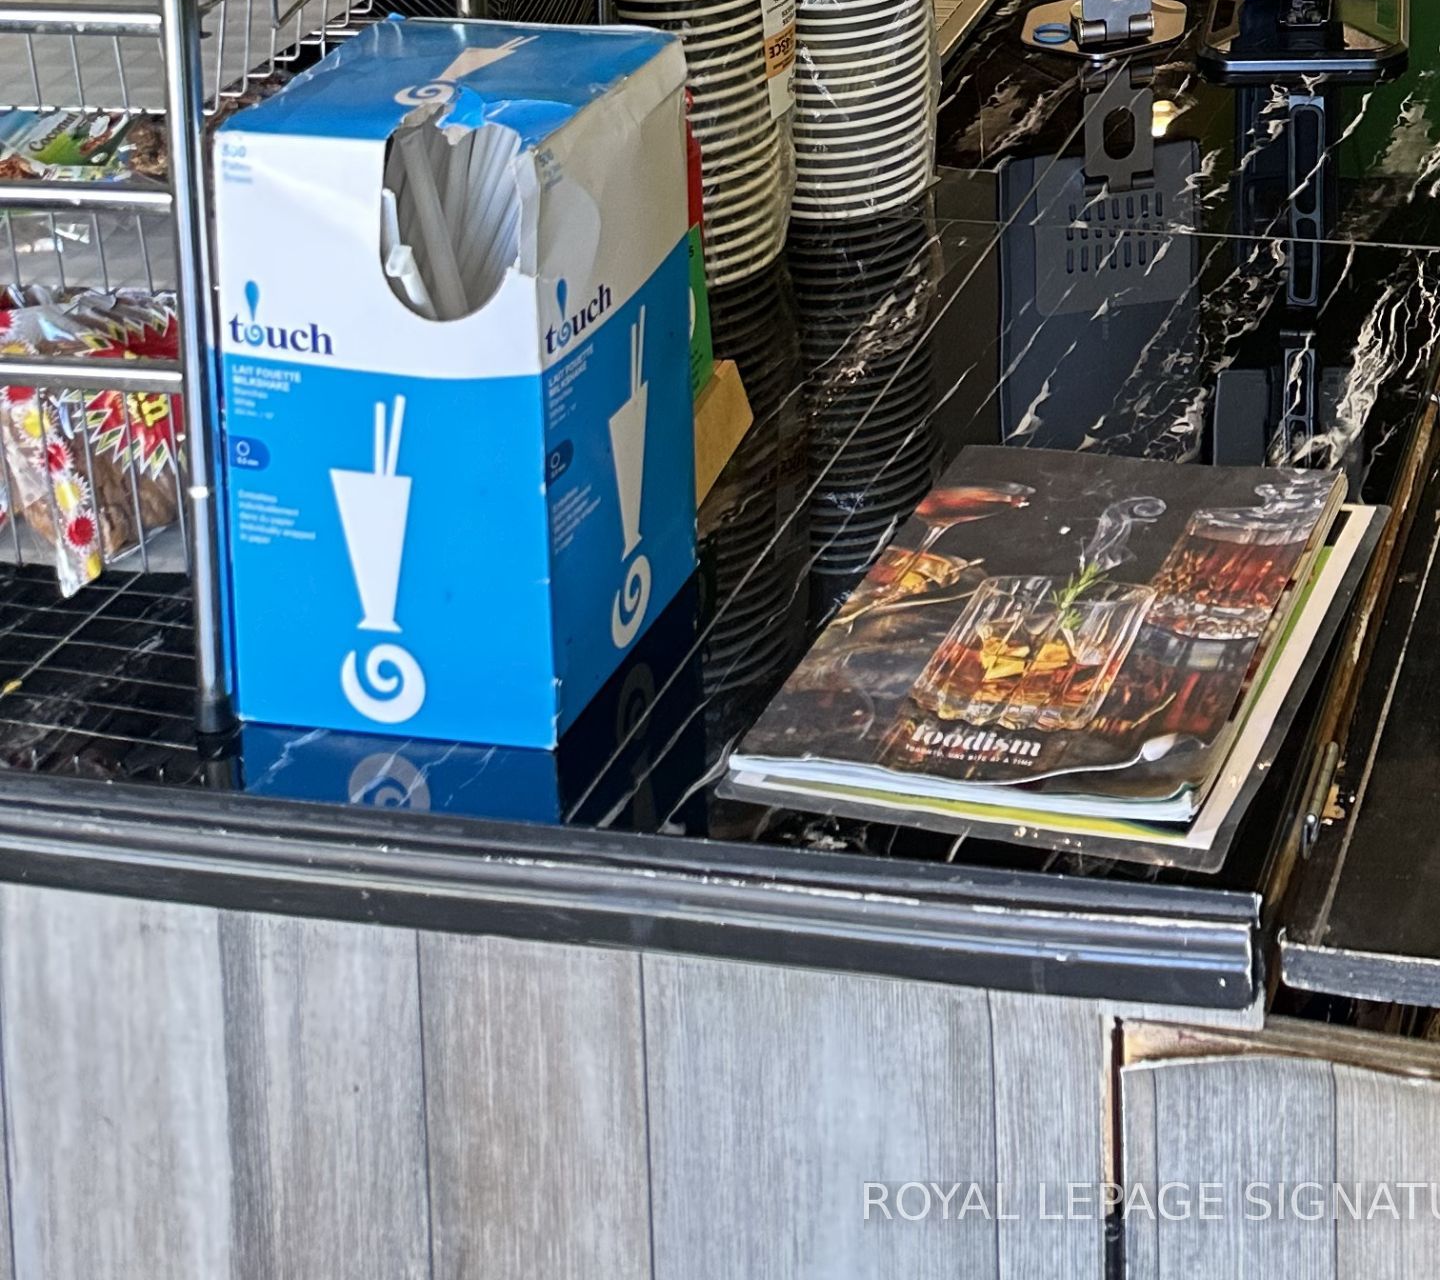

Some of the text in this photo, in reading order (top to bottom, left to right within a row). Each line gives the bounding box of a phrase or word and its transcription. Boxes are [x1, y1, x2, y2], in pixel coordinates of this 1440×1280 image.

[229, 312, 334, 356] touch
[545, 283, 612, 355] touch
[911, 722, 1042, 757] foodism
